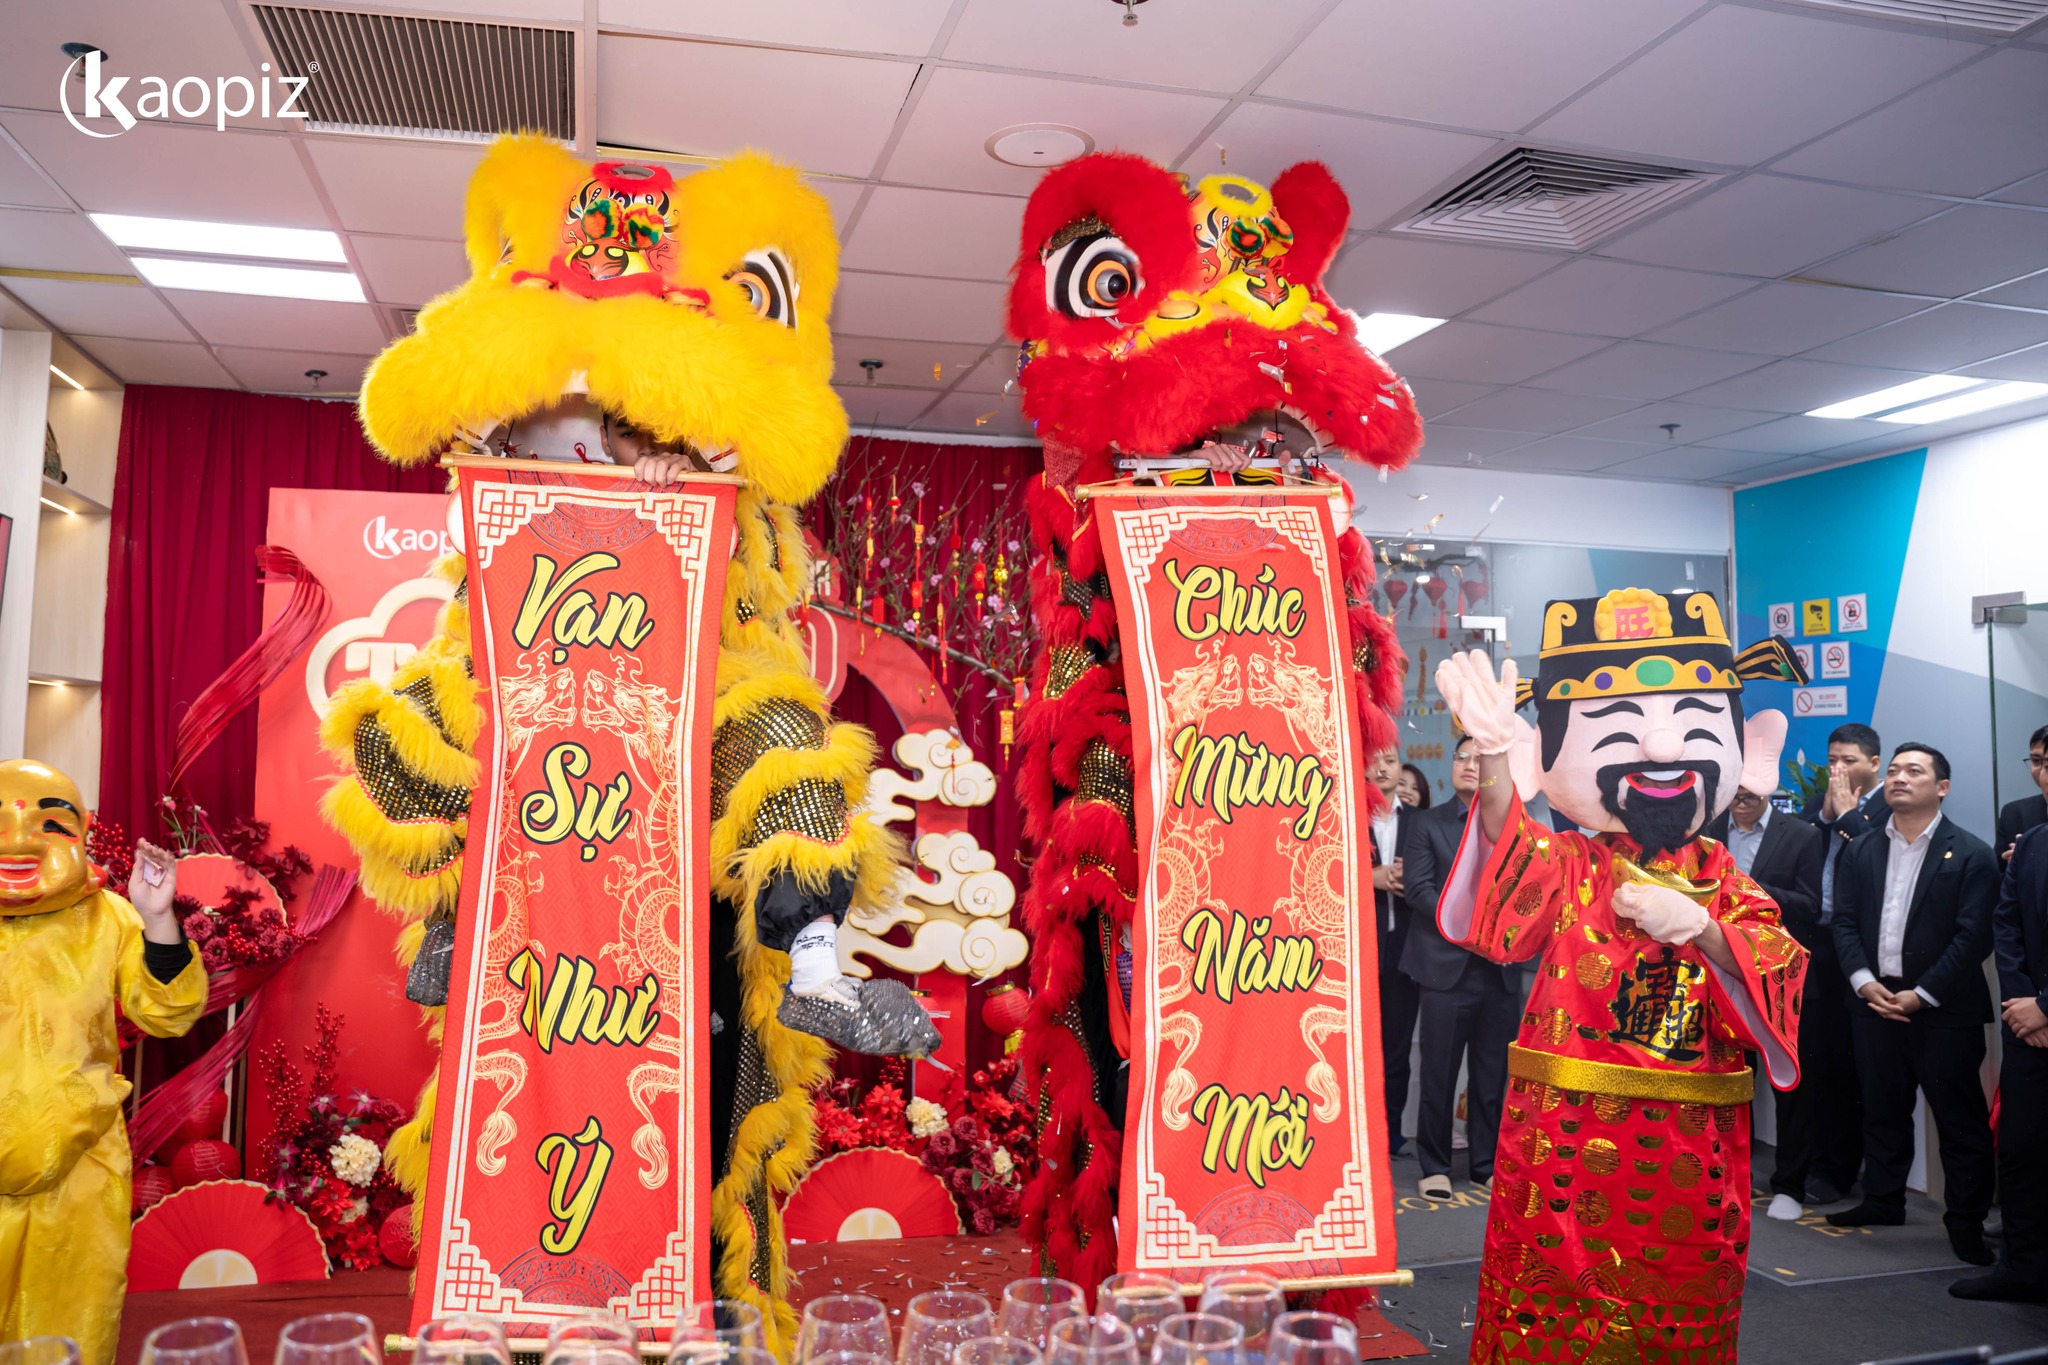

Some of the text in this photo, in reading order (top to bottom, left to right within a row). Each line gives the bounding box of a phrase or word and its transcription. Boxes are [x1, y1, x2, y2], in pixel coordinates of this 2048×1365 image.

[512, 552, 655, 665] Vạn
[1163, 558, 1306, 640] Chúc
[1614, 605, 1654, 640] 旺
[519, 741, 632, 862] Sự
[1172, 724, 1332, 840] Mừng
[506, 947, 660, 1054] Như
[1181, 908, 1323, 1004] Năm
[535, 1115, 614, 1256] Ý
[1191, 1083, 1315, 1189] Mới
